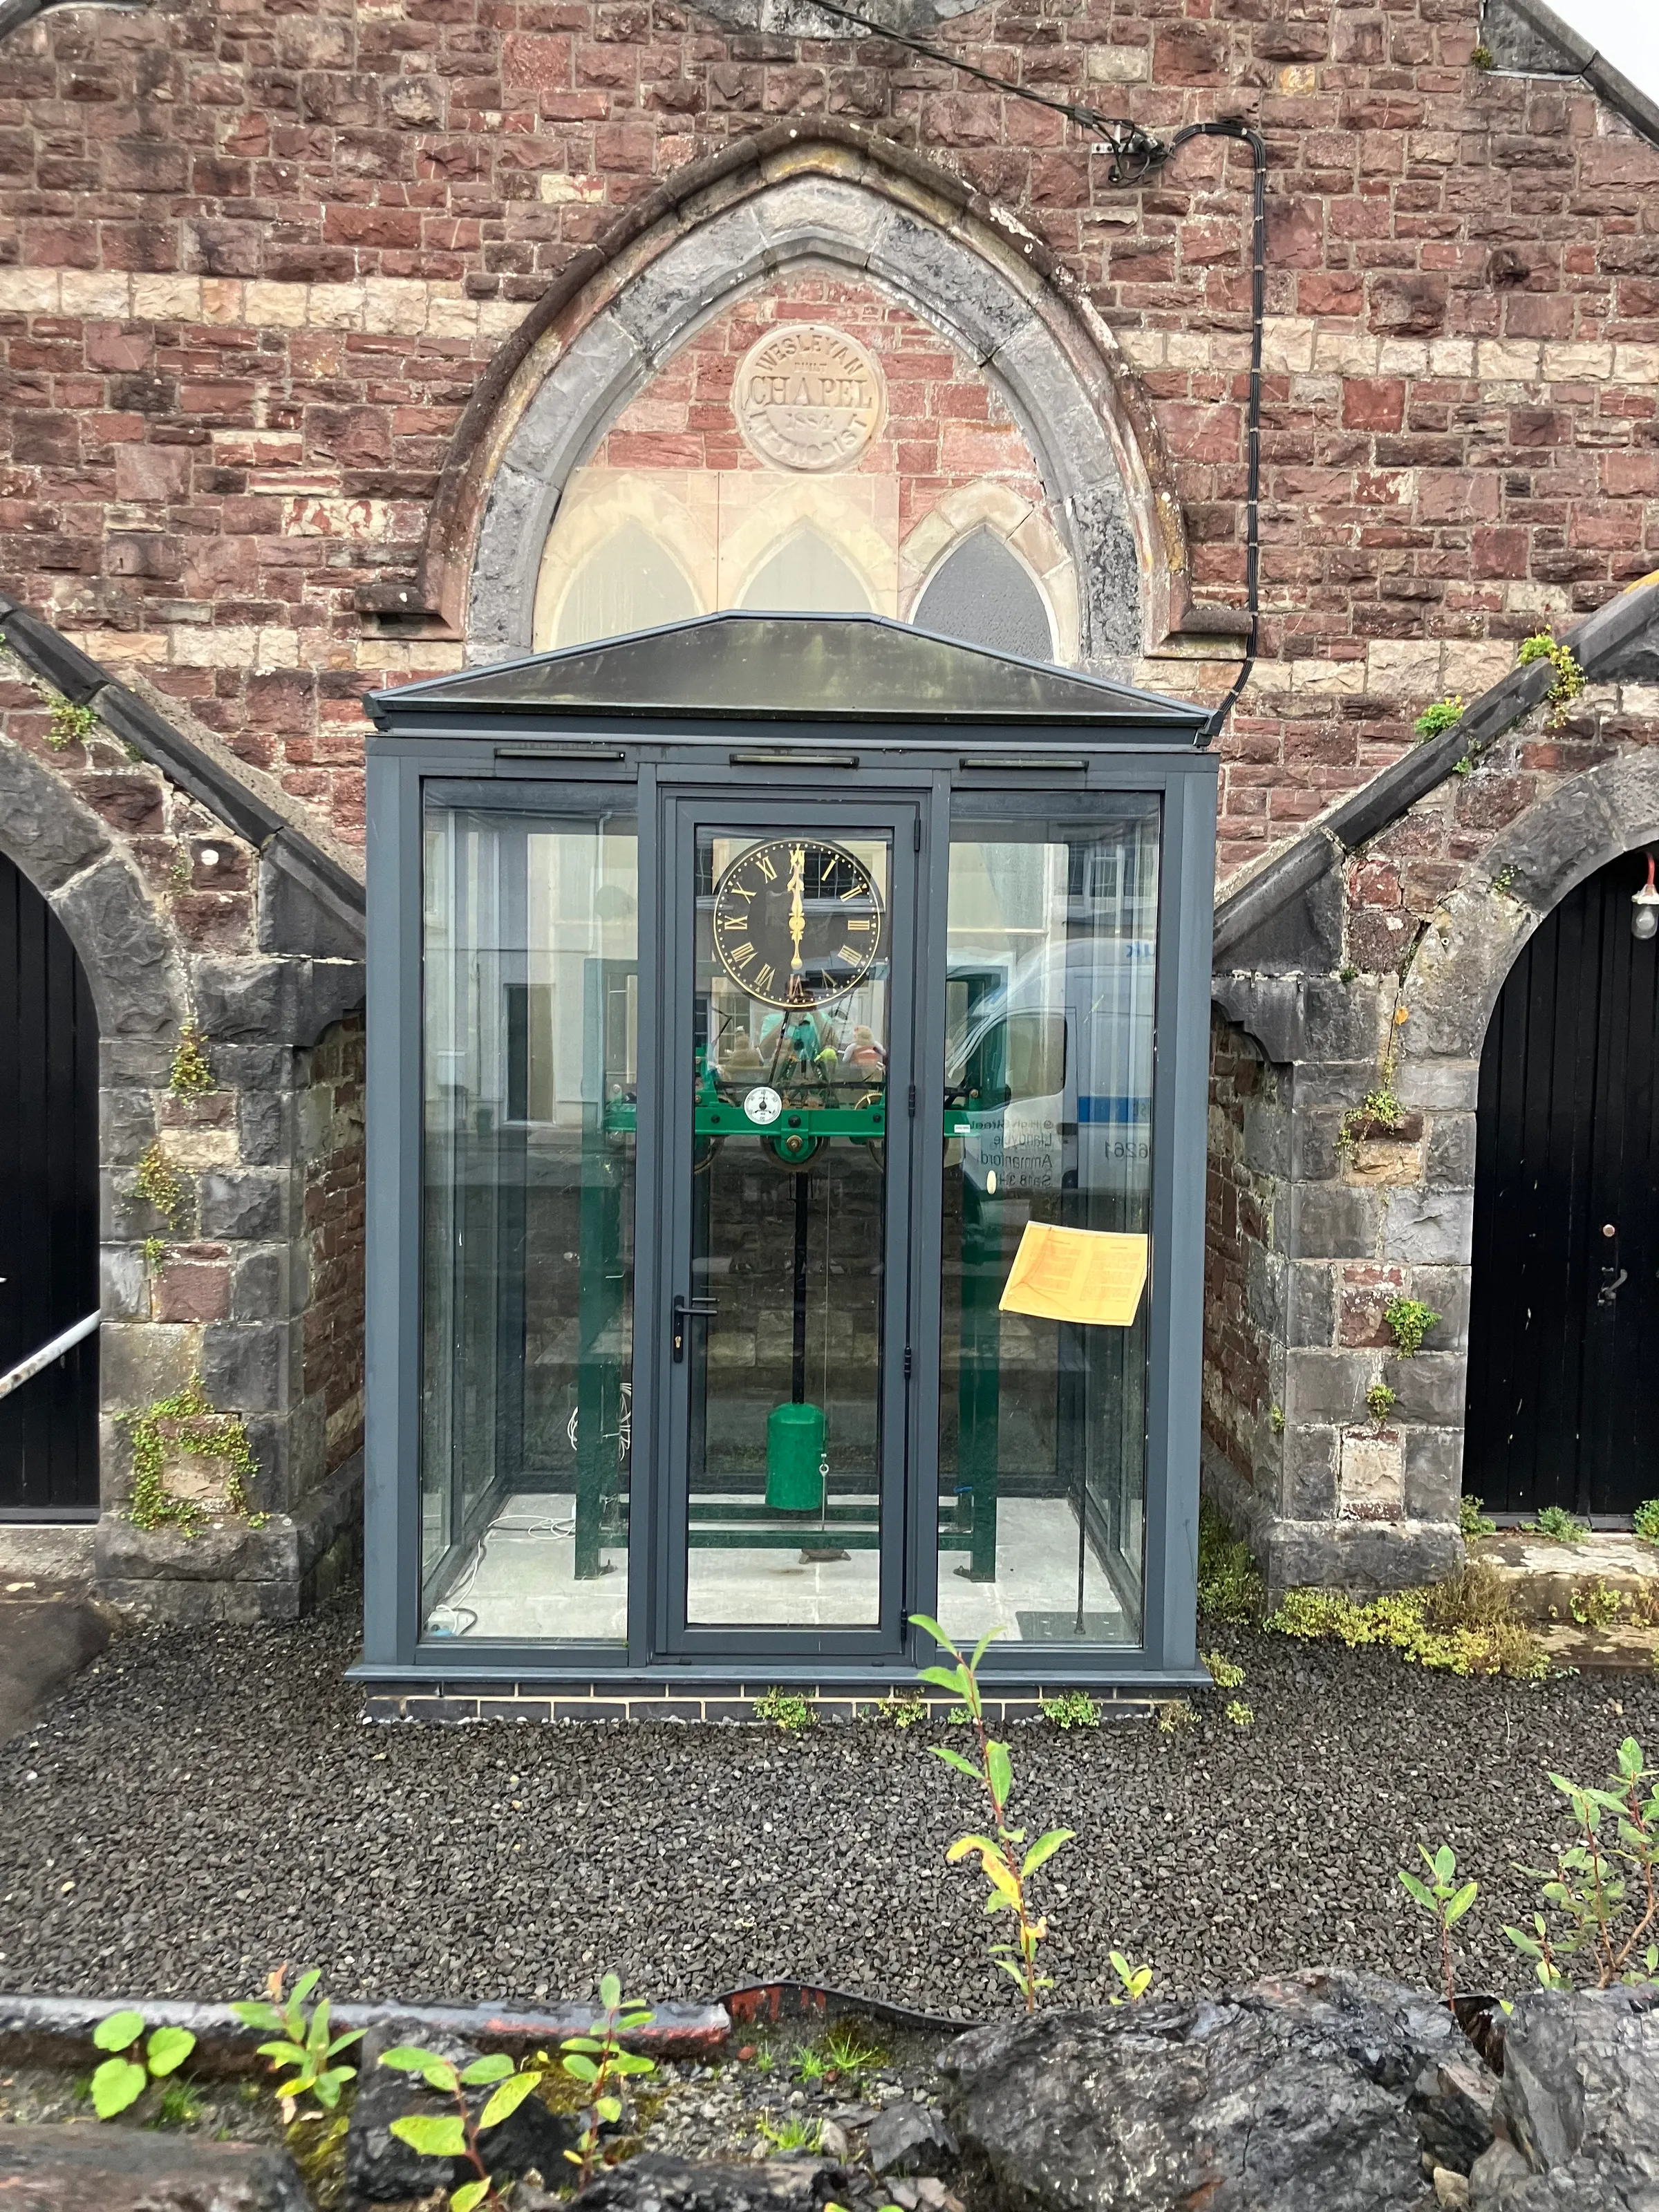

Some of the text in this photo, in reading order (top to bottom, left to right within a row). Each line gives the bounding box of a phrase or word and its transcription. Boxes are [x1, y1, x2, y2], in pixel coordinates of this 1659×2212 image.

[755, 334, 864, 375] WESLEYAN
[750, 375, 873, 409] CHAPEL
[755, 856, 778, 884] XI
[731, 881, 758, 904] X
[847, 919, 870, 930] III
